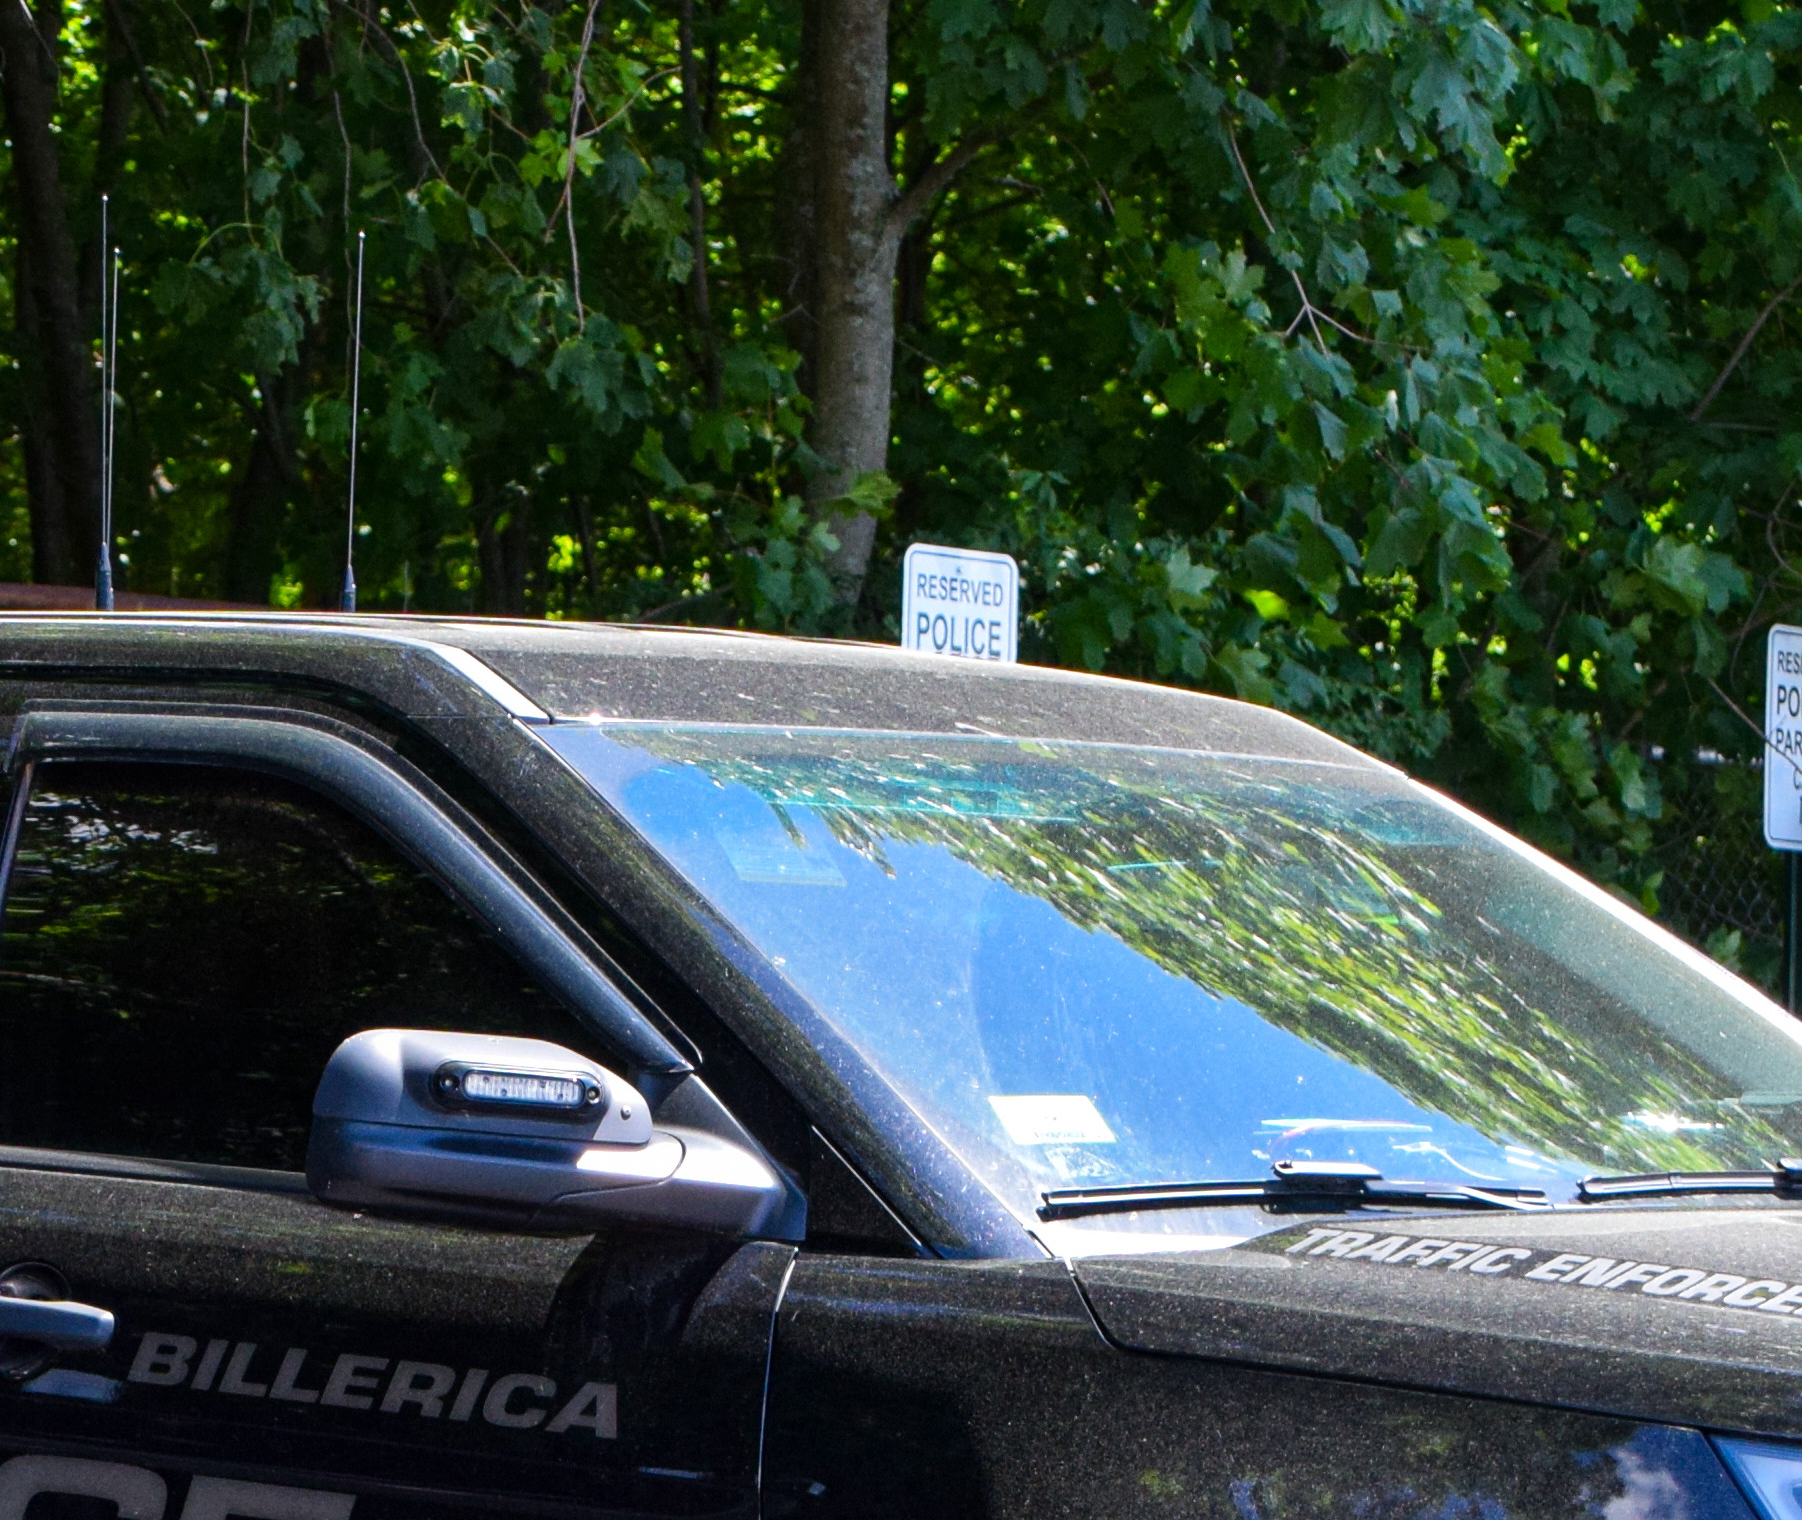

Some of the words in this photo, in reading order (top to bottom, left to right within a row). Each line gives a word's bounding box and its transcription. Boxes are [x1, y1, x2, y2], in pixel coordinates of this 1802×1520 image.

[917, 573, 1004, 607] RESERVED
[916, 612, 1001, 657] POLICE
[1285, 1228, 1530, 1275] TRAFFIC
[127, 1332, 620, 1439] BILLERICA
